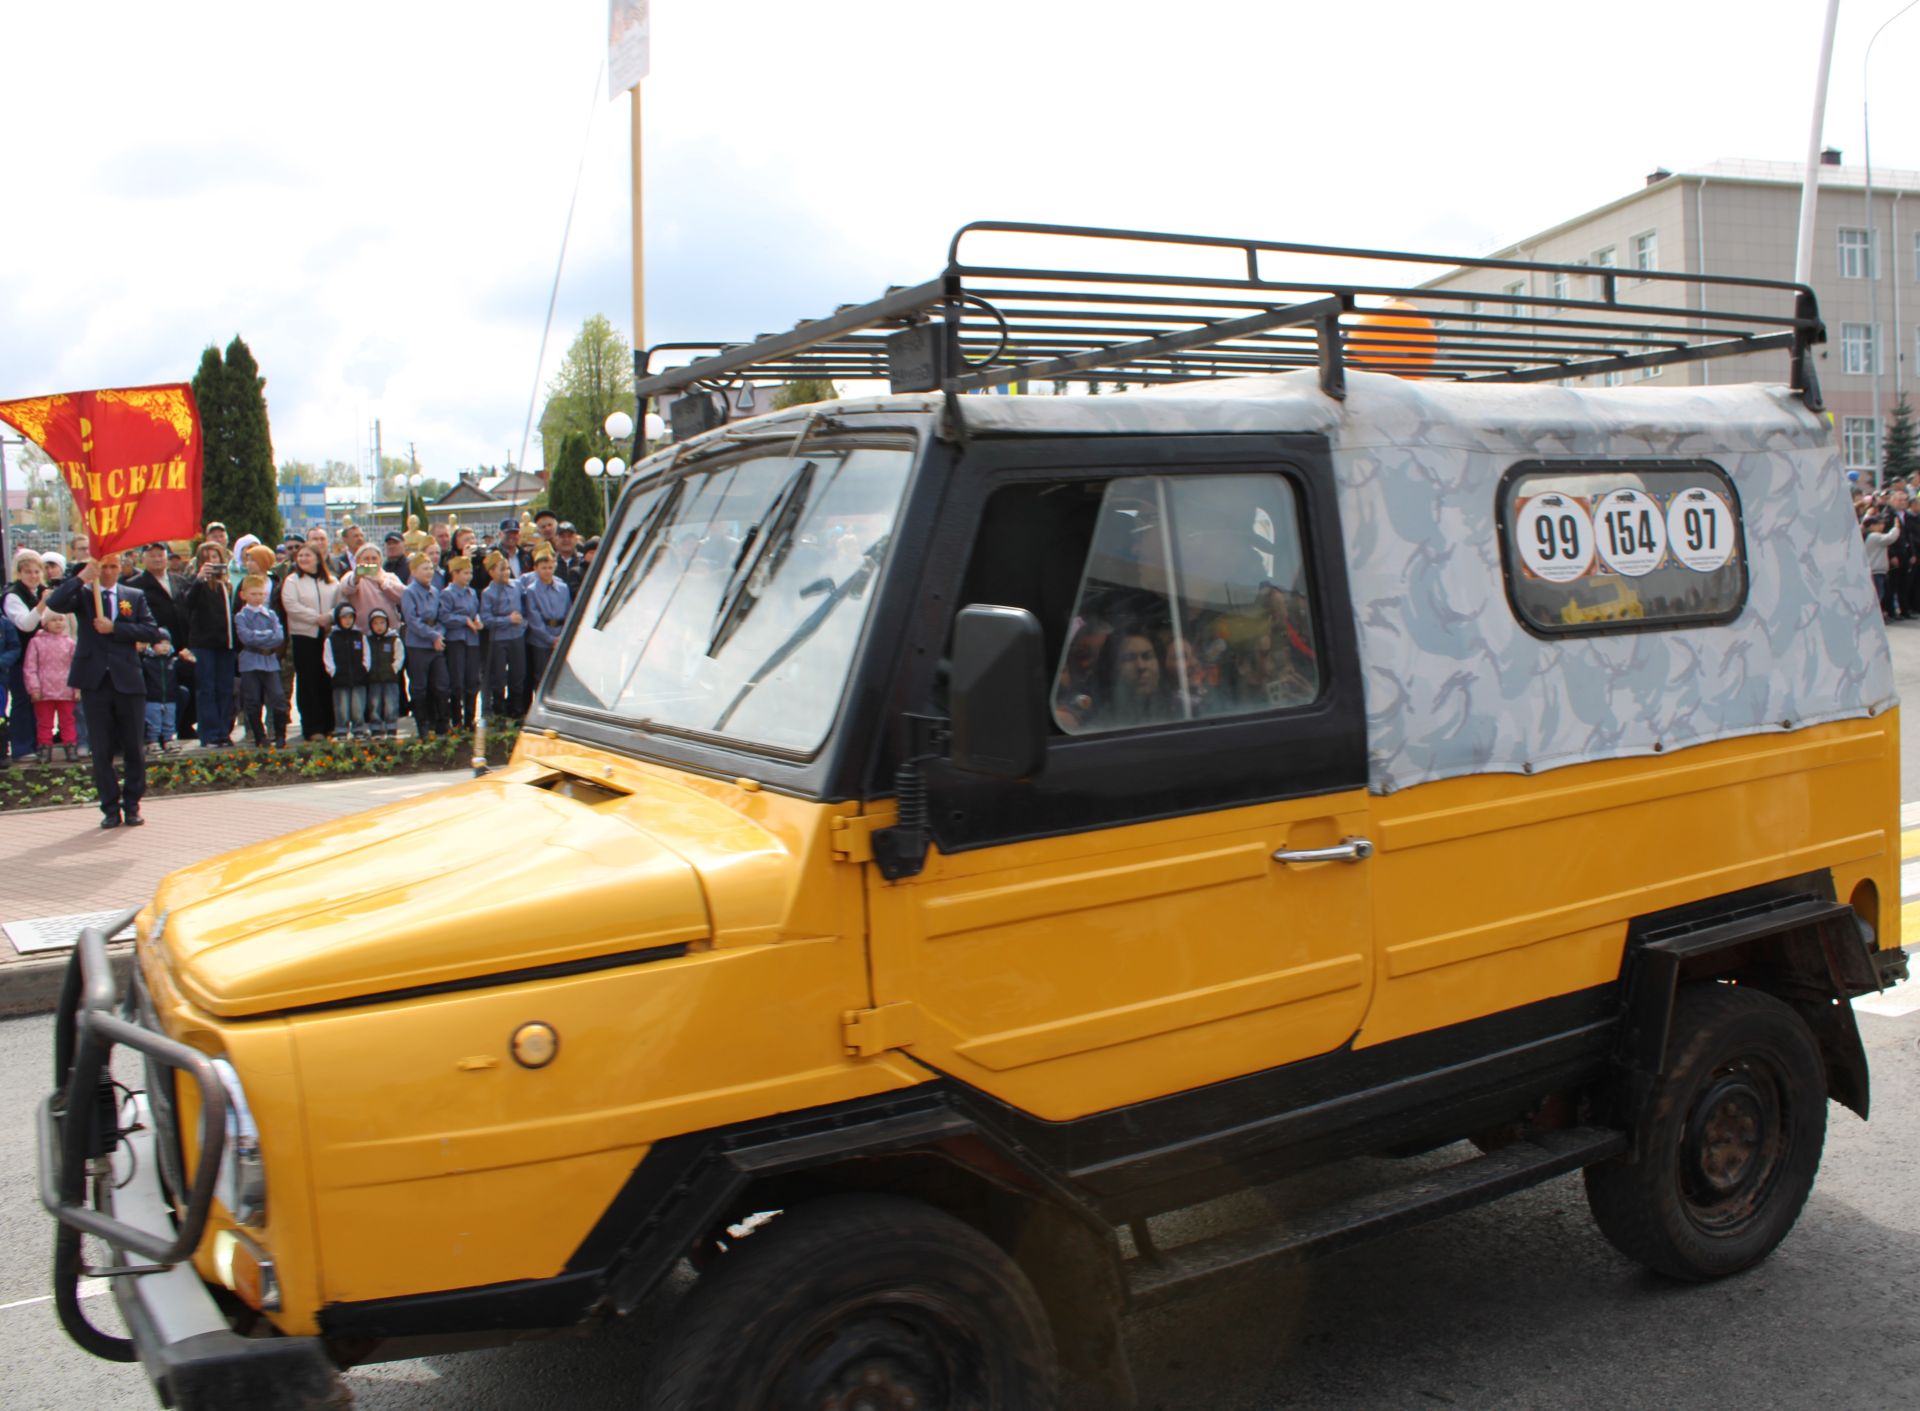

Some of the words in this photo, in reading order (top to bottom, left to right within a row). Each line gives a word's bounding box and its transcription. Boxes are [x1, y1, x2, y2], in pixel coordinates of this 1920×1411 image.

[1535, 514, 1581, 560] 99
[1605, 509, 1657, 555] 154
[1684, 507, 1717, 551] 97
